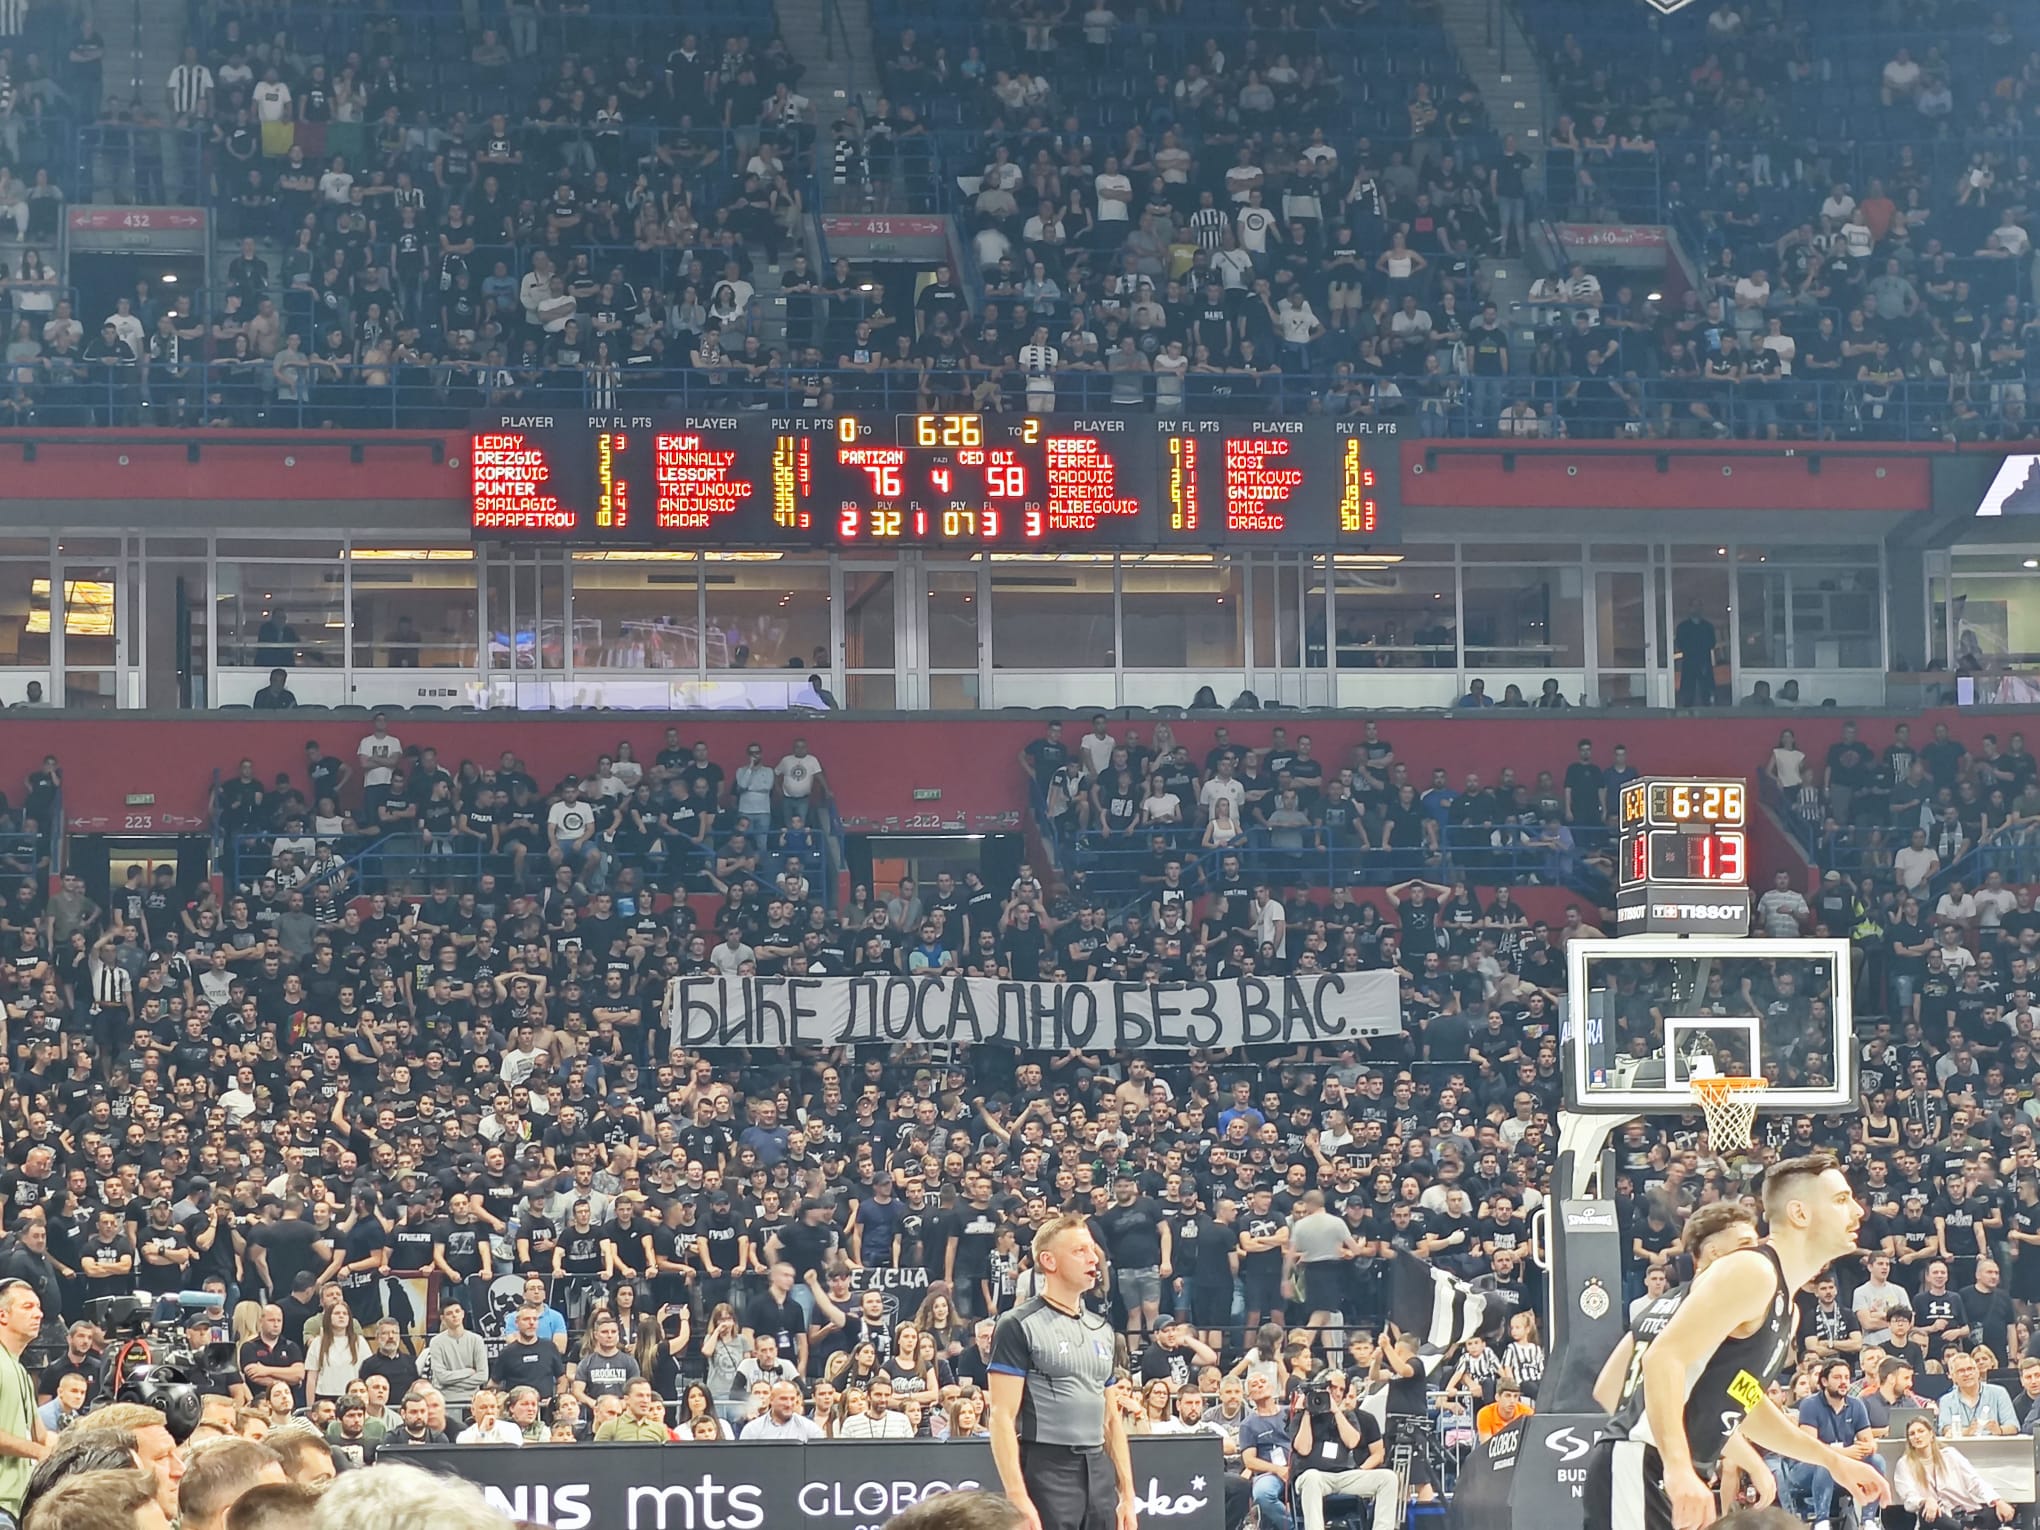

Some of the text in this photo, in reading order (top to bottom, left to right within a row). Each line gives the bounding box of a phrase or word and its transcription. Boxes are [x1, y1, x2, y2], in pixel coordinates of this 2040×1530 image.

[123, 213, 150, 226] 432
[866, 222, 892, 234] 431
[501, 417, 652, 429] PLAYER PLY FL PTS
[685, 418, 834, 430] PLAYER PLY FL PTS
[840, 418, 872, 442] 0 TO
[1074, 420, 1220, 432] PLAYER PLY FL PTS
[1252, 422, 1397, 434] PLAYER PLY FL PTS
[918, 416, 980, 446] 6:26
[1008, 420, 1038, 444] TO 2
[475, 435, 626, 450] LEDAY 2 3
[659, 436, 698, 450] EXUM
[777, 437, 794, 450] 11
[1048, 439, 1194, 454] REBEC 0 3
[1228, 440, 1358, 454] MULALIC 9
[475, 450, 611, 465] DREZGIC 3
[659, 452, 808, 466] NUNNALLY 21 3
[840, 450, 904, 465] PARTIZAN
[959, 452, 1014, 465] CED OLI
[1048, 455, 1194, 468] FERRELL 1 2
[1228, 456, 1358, 470] KOSI 15
[475, 466, 611, 480] KOPRIVIC 5
[659, 468, 808, 482] LESSORT 26 3
[1049, 470, 1113, 484] RADOVIC
[1171, 469, 1180, 482] 3
[1228, 471, 1373, 486] MATKOVIC 17 5
[864, 467, 900, 496] 76
[932, 470, 948, 493] 4
[988, 467, 1024, 496] 58
[475, 482, 626, 496] PUNTER 7 2
[660, 483, 751, 496] TRIFUNOVIC
[775, 483, 794, 496] 32
[1049, 484, 1195, 498] JEREMIC 6 2
[1228, 486, 1360, 500] GNJIDIC 19
[475, 497, 626, 512] SMAILAGIC 9 4
[659, 498, 794, 512] ANDJUSIC 33
[842, 502, 857, 511] BO
[877, 502, 892, 511] PLY
[910, 502, 922, 511] FL
[950, 502, 966, 511] PLY
[983, 502, 995, 511] FL
[1024, 502, 1040, 511] BO
[1049, 500, 1195, 514] ALIBEGOVIC 7 3
[1228, 500, 1374, 515] OMIC 24 3
[476, 512, 626, 527] PAPAPETROU 10 2
[660, 514, 809, 527] MADAR 41 3
[840, 512, 856, 536] 2
[870, 512, 900, 536] 32
[917, 512, 924, 535] 1
[944, 512, 974, 535] 07
[982, 512, 998, 536] 3
[1026, 512, 1041, 536] 3
[1050, 514, 1196, 530] MURIC 8 2
[1228, 516, 1374, 530] DRAGIC 30 2
[1672, 787, 1740, 818] 6:26
[124, 816, 152, 828] 223
[1677, 905, 1744, 920] TISSOT
[681, 976, 1379, 1049] БИЋЕ ДОСАДНО БЕЗ ВАС...
[868, 1267, 929, 1291] ДЕЦА
[590, 1368, 626, 1379] BROOKLYN
[1488, 1429, 1519, 1458] GLOBOS
[628, 1474, 764, 1530] mts
